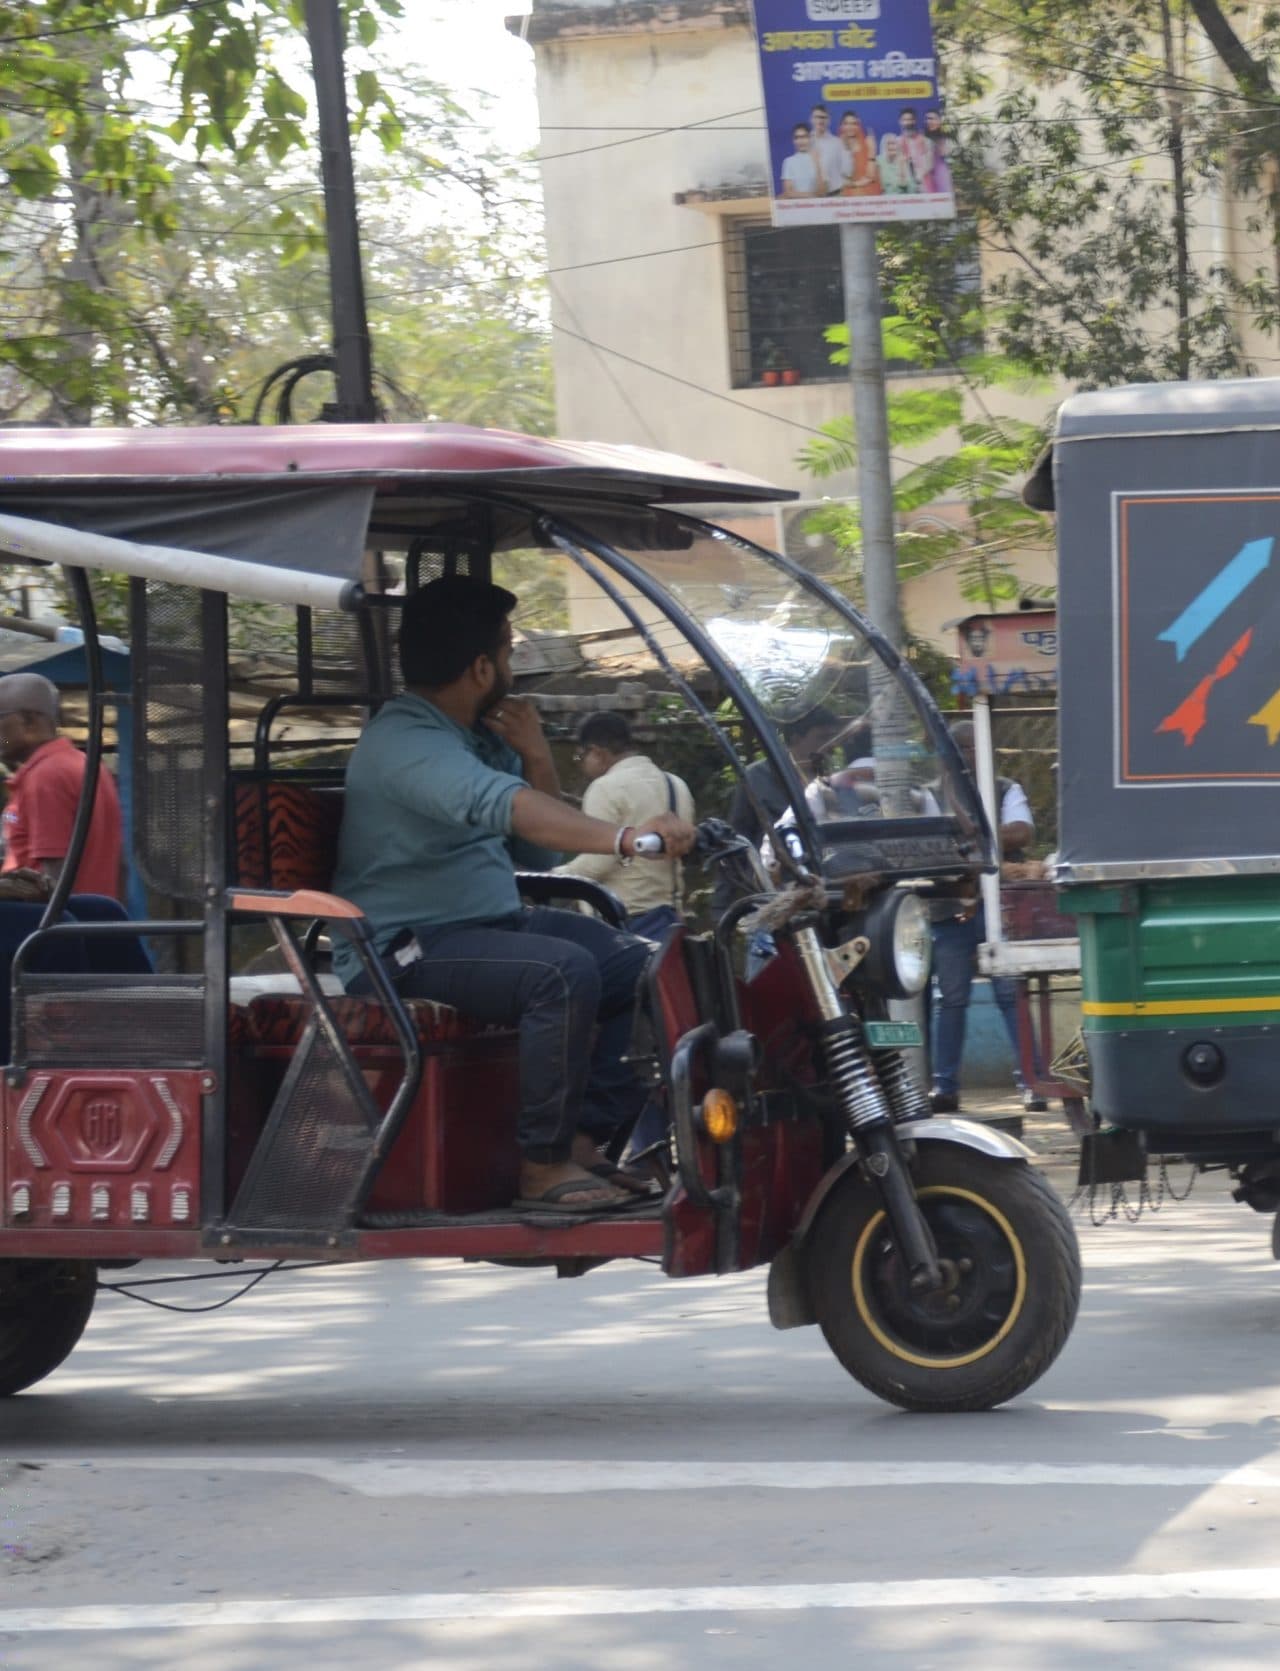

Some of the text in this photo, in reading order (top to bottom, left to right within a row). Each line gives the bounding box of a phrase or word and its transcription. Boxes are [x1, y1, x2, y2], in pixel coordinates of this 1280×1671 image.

[761, 22, 876, 52] आपका वोट
[792, 61, 865, 81] आपका
